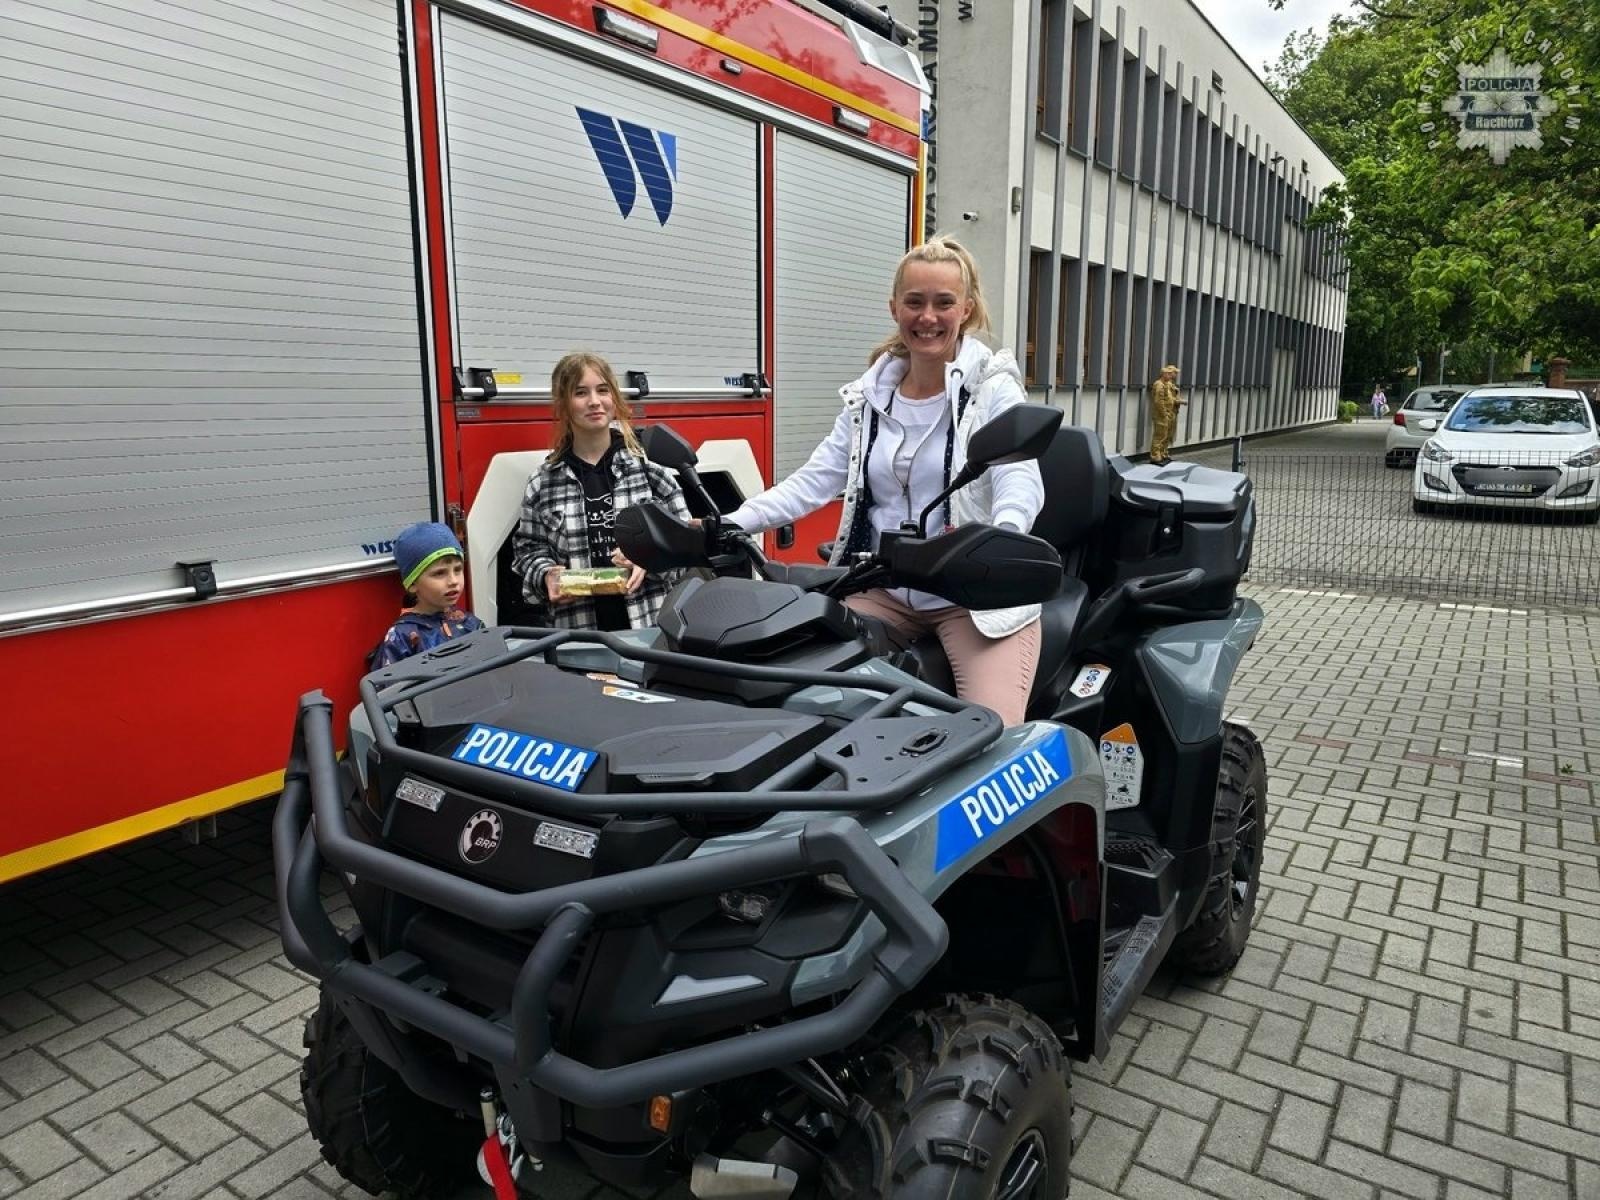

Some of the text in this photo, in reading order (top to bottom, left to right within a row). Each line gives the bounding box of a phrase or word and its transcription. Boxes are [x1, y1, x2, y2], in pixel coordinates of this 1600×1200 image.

[918, 0, 938, 52] MU
[361, 539, 397, 556] WIS
[458, 727, 589, 787] POLICJA
[959, 749, 1060, 838] POLICJA
